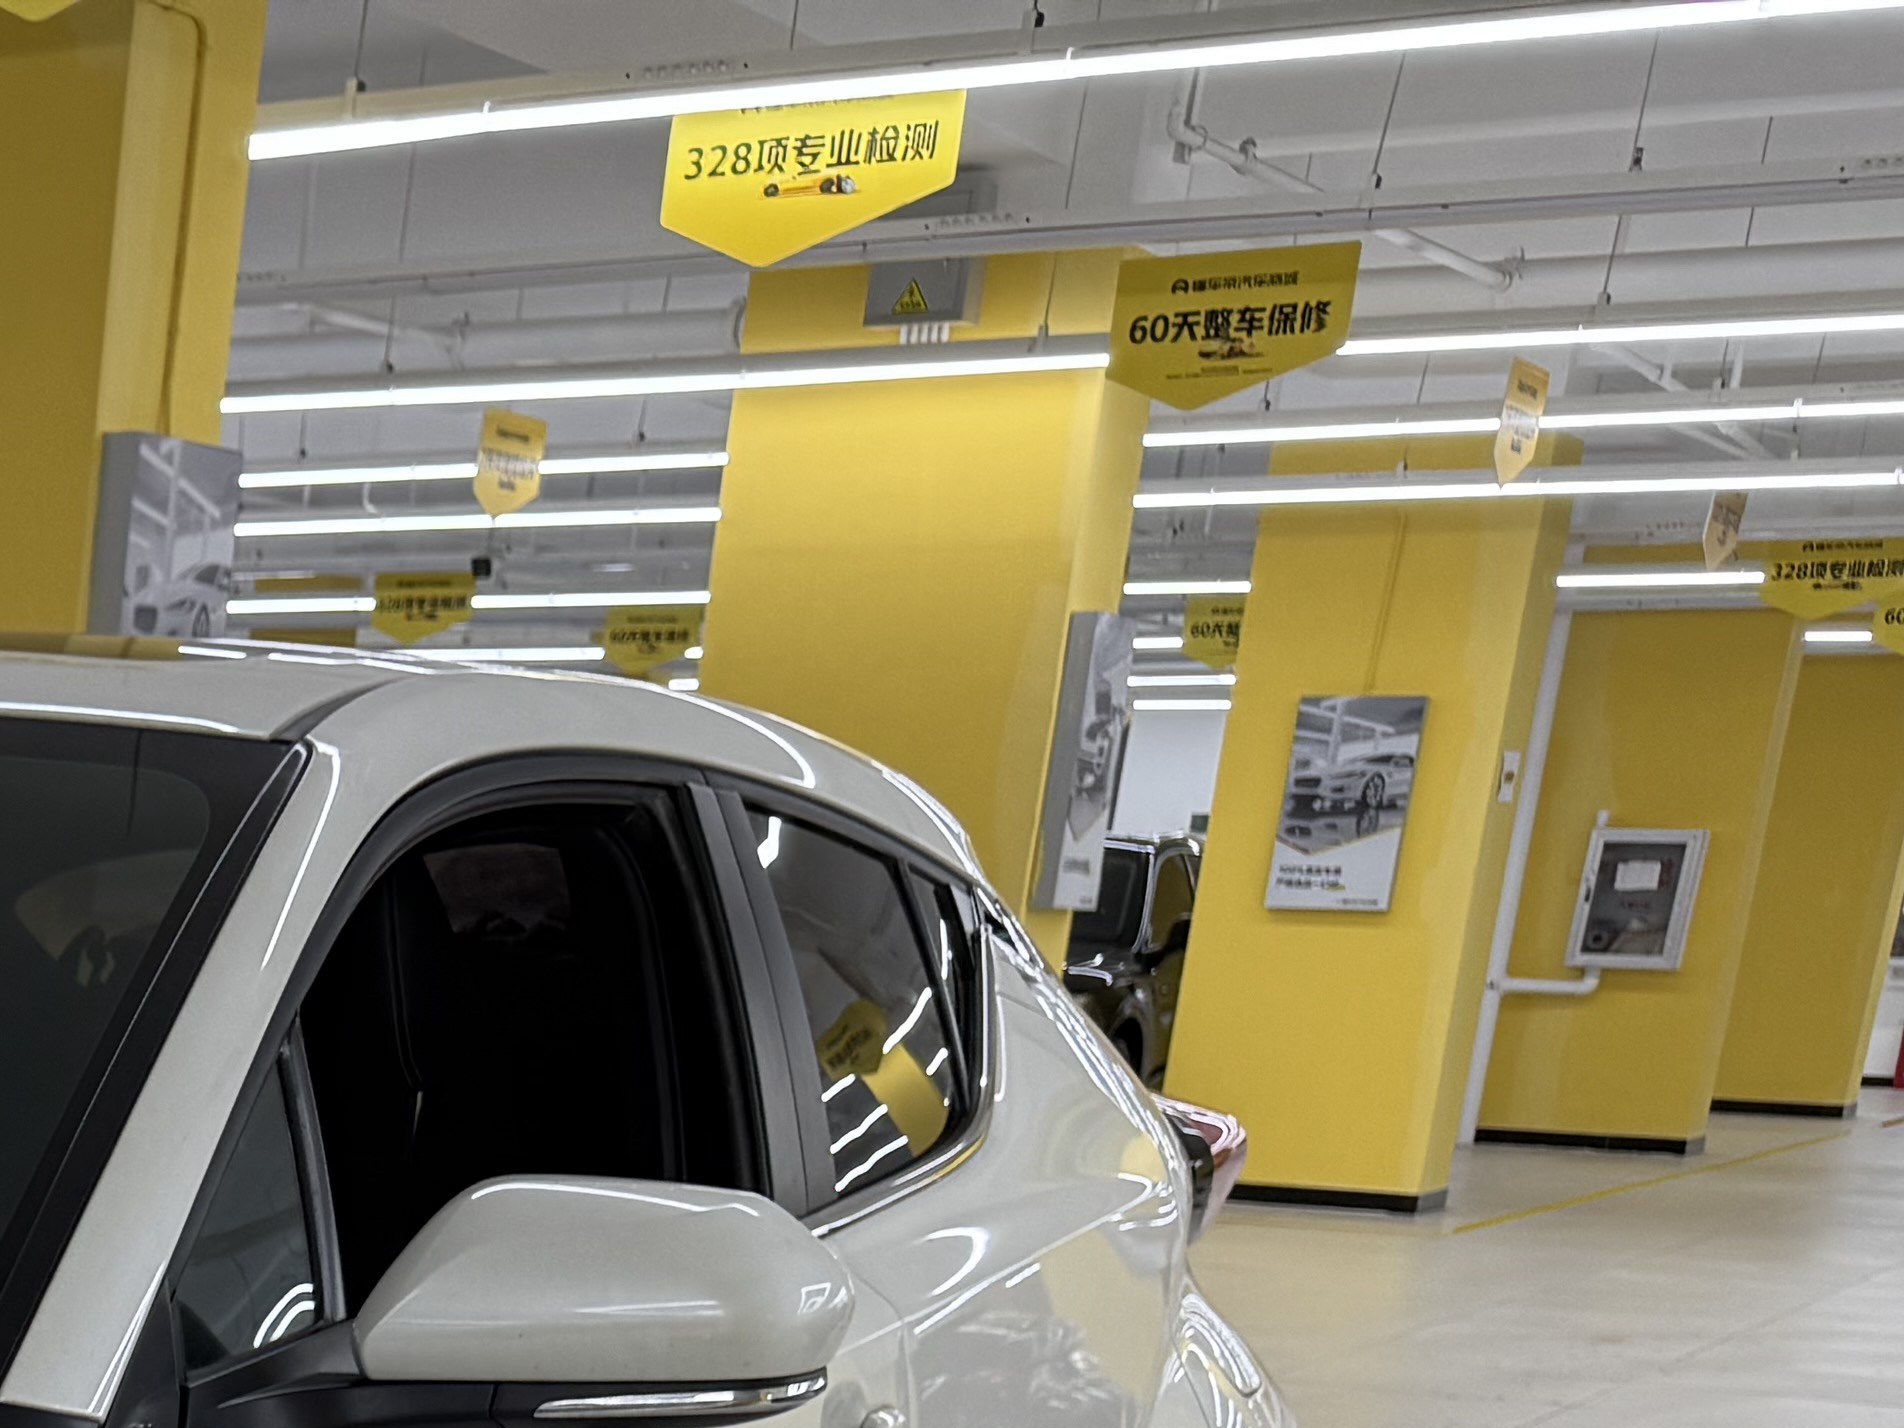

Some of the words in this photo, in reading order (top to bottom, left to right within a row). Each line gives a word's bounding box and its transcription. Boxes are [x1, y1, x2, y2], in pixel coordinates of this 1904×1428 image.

[683, 119, 939, 180] 328项专业检测
[1129, 301, 1332, 344] 60天整车保修
